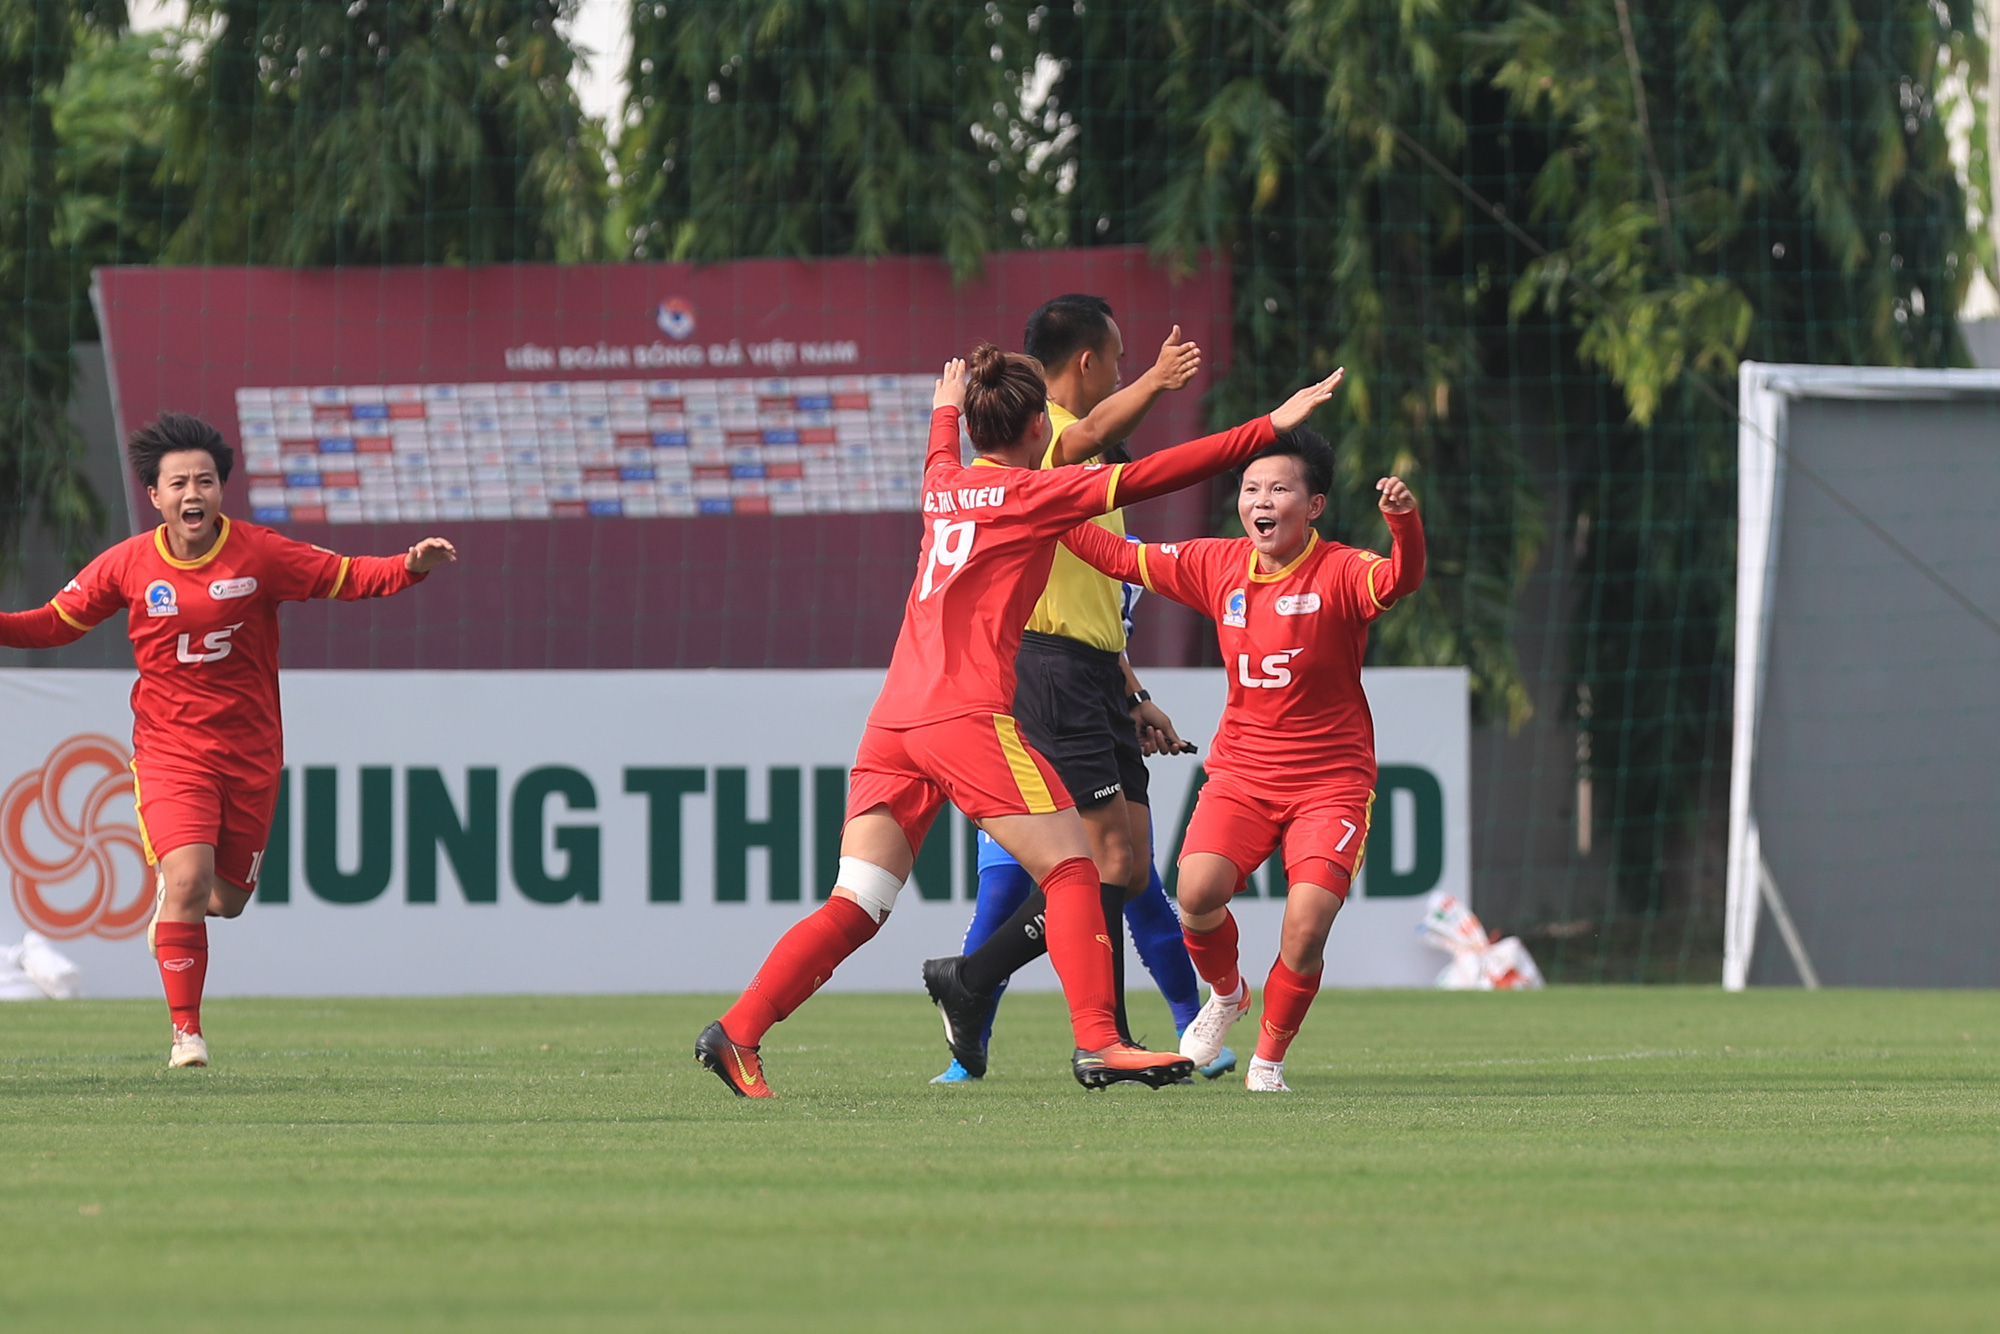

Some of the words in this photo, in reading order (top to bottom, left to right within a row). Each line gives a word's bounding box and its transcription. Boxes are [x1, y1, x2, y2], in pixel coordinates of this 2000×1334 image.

[801, 340, 857, 366] NAM
[919, 518, 976, 602] 19
[176, 629, 233, 664] LS
[1237, 653, 1293, 689] LS
[1093, 782, 1122, 800] mitre
[1334, 818, 1357, 852] 7
